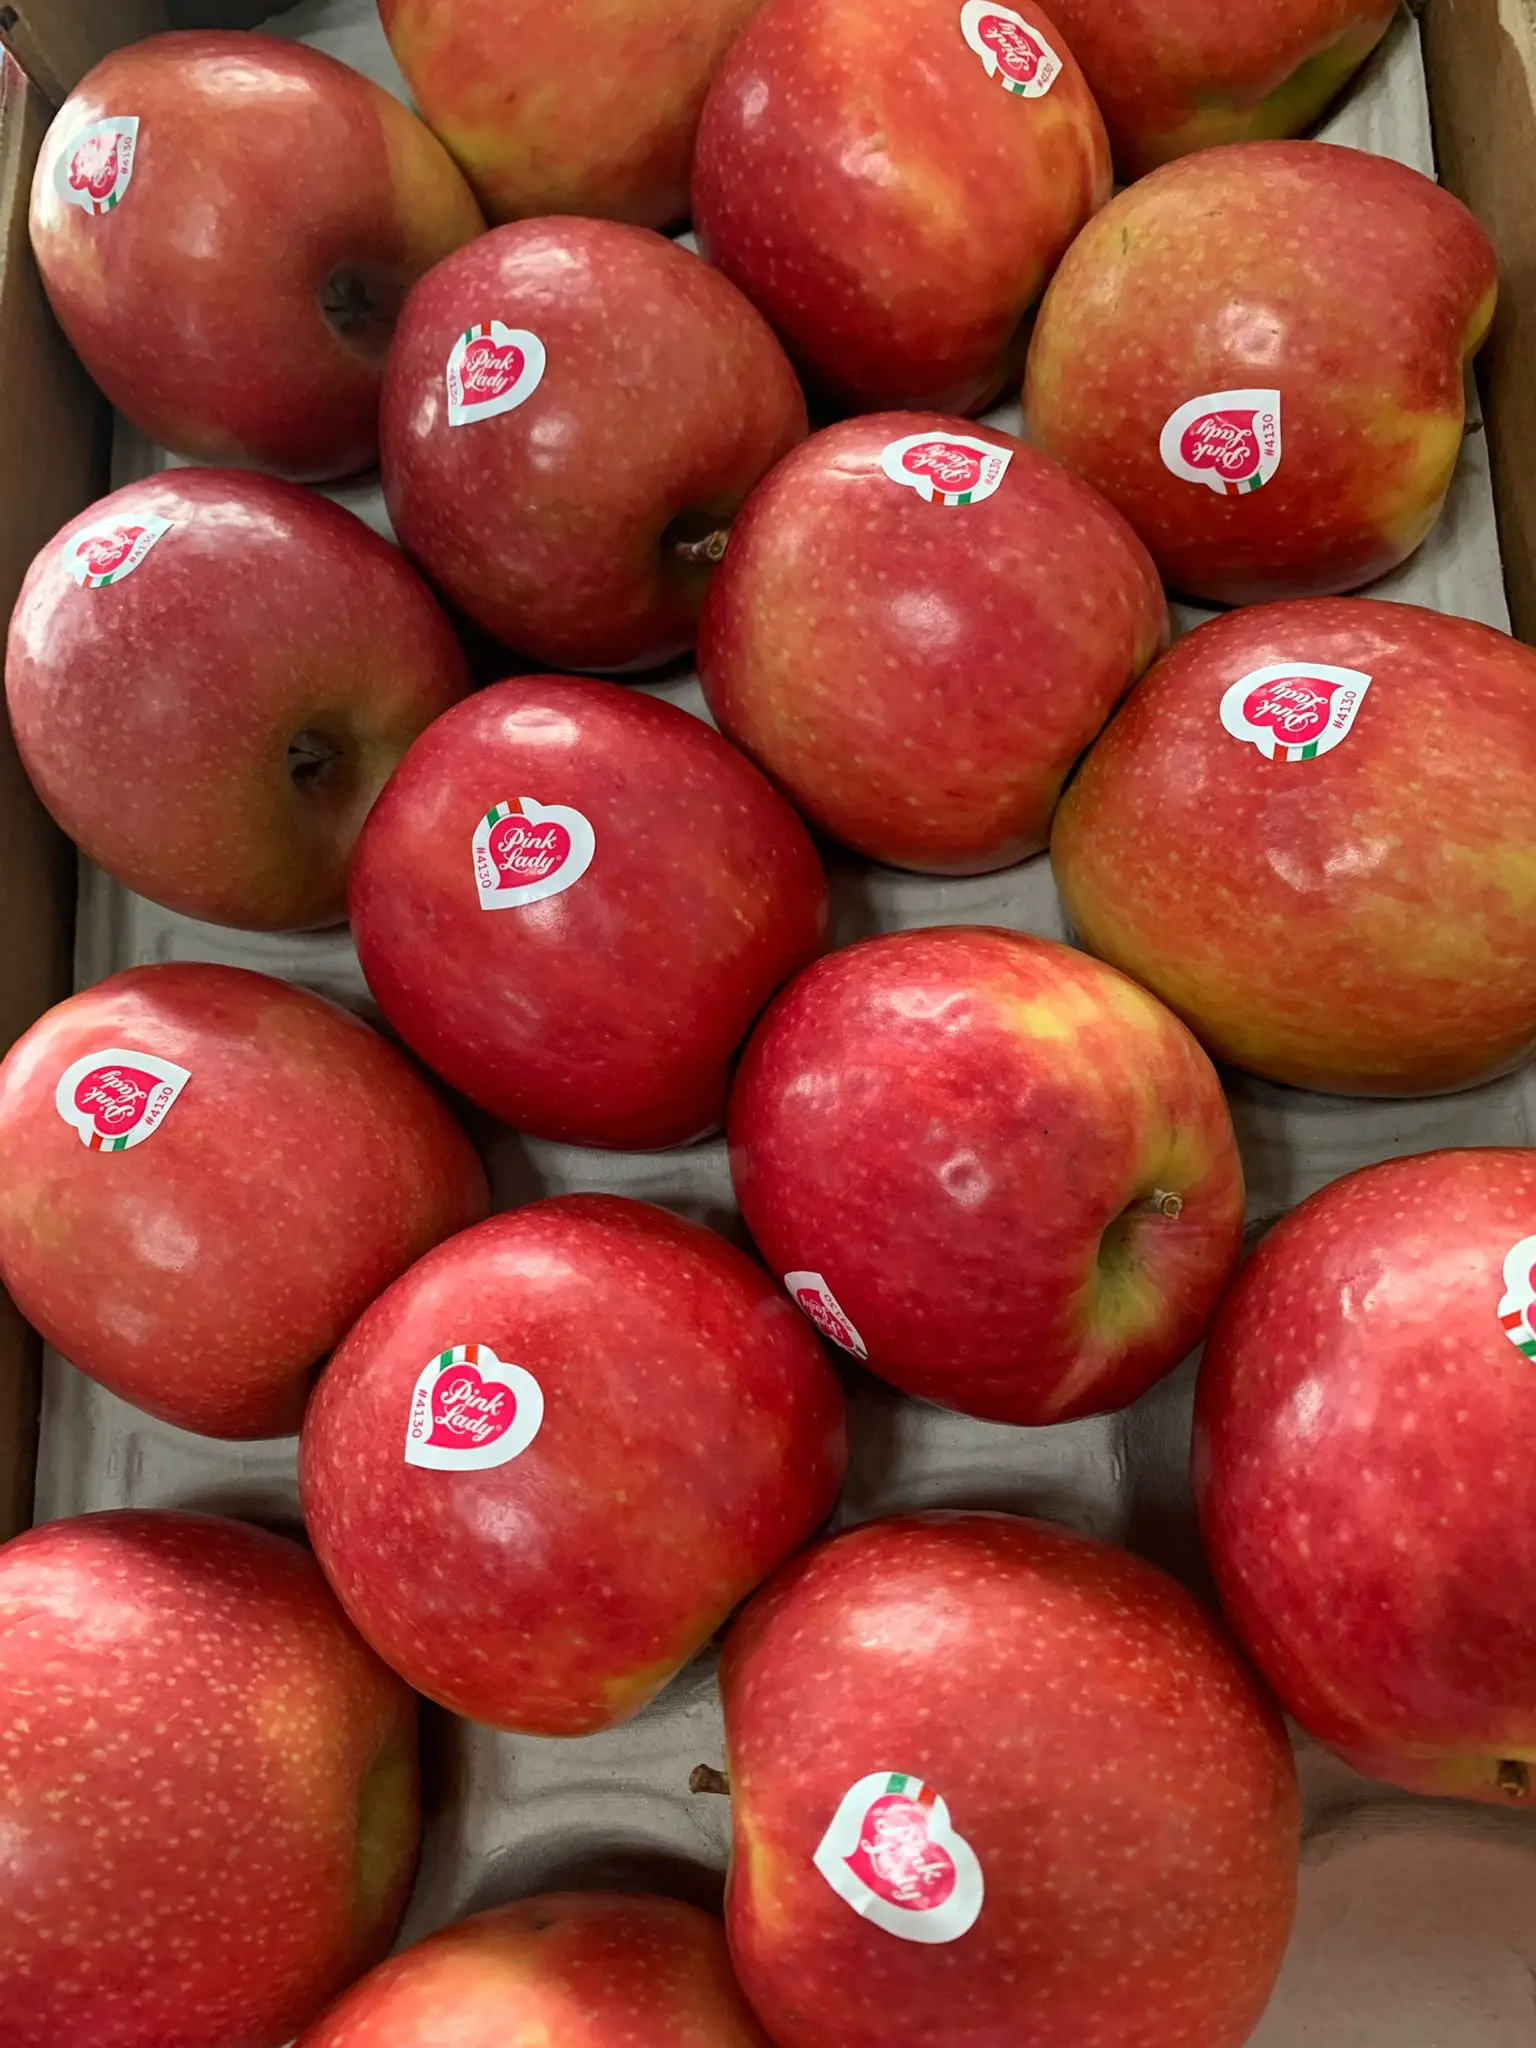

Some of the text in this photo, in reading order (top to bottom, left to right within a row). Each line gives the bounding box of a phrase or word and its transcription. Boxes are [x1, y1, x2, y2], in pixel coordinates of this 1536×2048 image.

[984, 26, 1029, 71] Pink
[996, 21, 1038, 62] Lady
[466, 348, 514, 372] Pink
[464, 368, 509, 394] Lady
[1195, 418, 1252, 449] Lady
[1262, 413, 1276, 456] #4130
[1191, 442, 1251, 469] Pink
[1269, 681, 1328, 711] Lady
[1333, 690, 1357, 729] #4130
[1253, 700, 1319, 732] Pink
[497, 827, 557, 853] Pink
[476, 847, 492, 888] #4130
[498, 847, 555, 875] Lady
[82, 1086, 135, 1123] Pink
[99, 1070, 147, 1105] Lady
[145, 1086, 173, 1126] #4130
[412, 1389, 428, 1439] #4130
[440, 1378, 505, 1416] Pink
[434, 1403, 495, 1442] Lady
